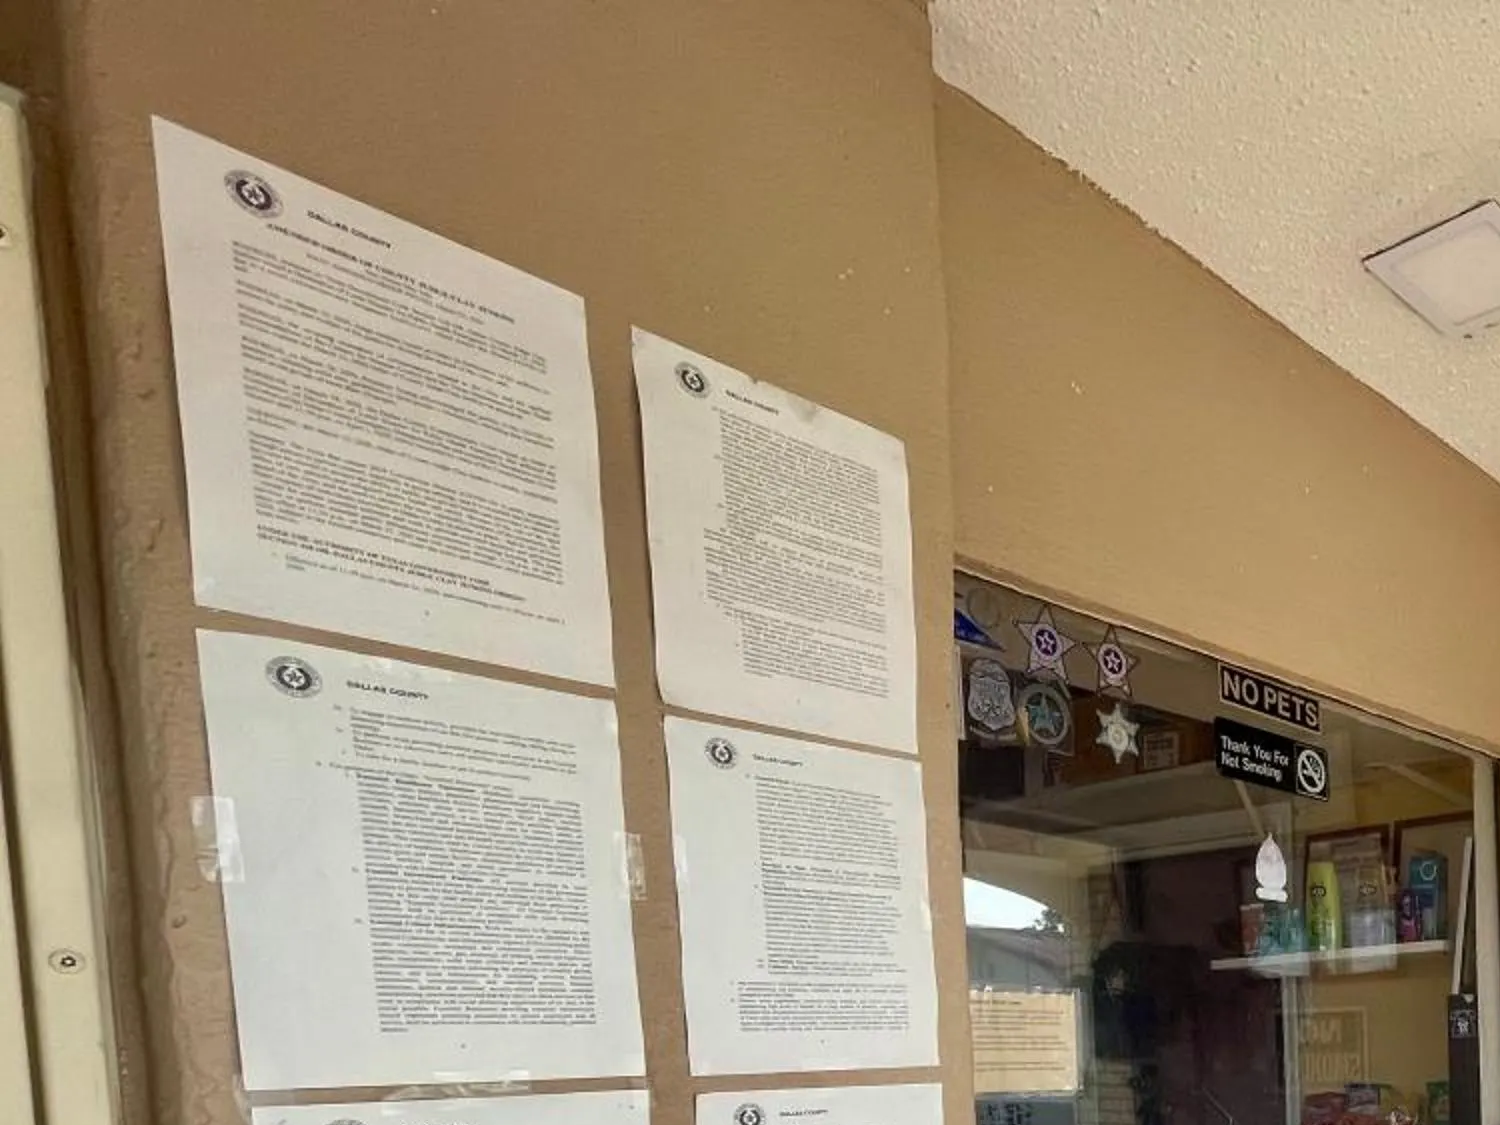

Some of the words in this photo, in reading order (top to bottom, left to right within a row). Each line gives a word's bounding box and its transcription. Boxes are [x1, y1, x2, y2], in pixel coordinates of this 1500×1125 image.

[1222, 670, 1260, 706] NO
[1263, 685, 1318, 727] PETS
[1220, 735, 1251, 756] Thank
[1253, 744, 1273, 761] You
[1274, 750, 1289, 766] For
[1221, 751, 1240, 769] Not
[1241, 758, 1283, 782] Smoking
